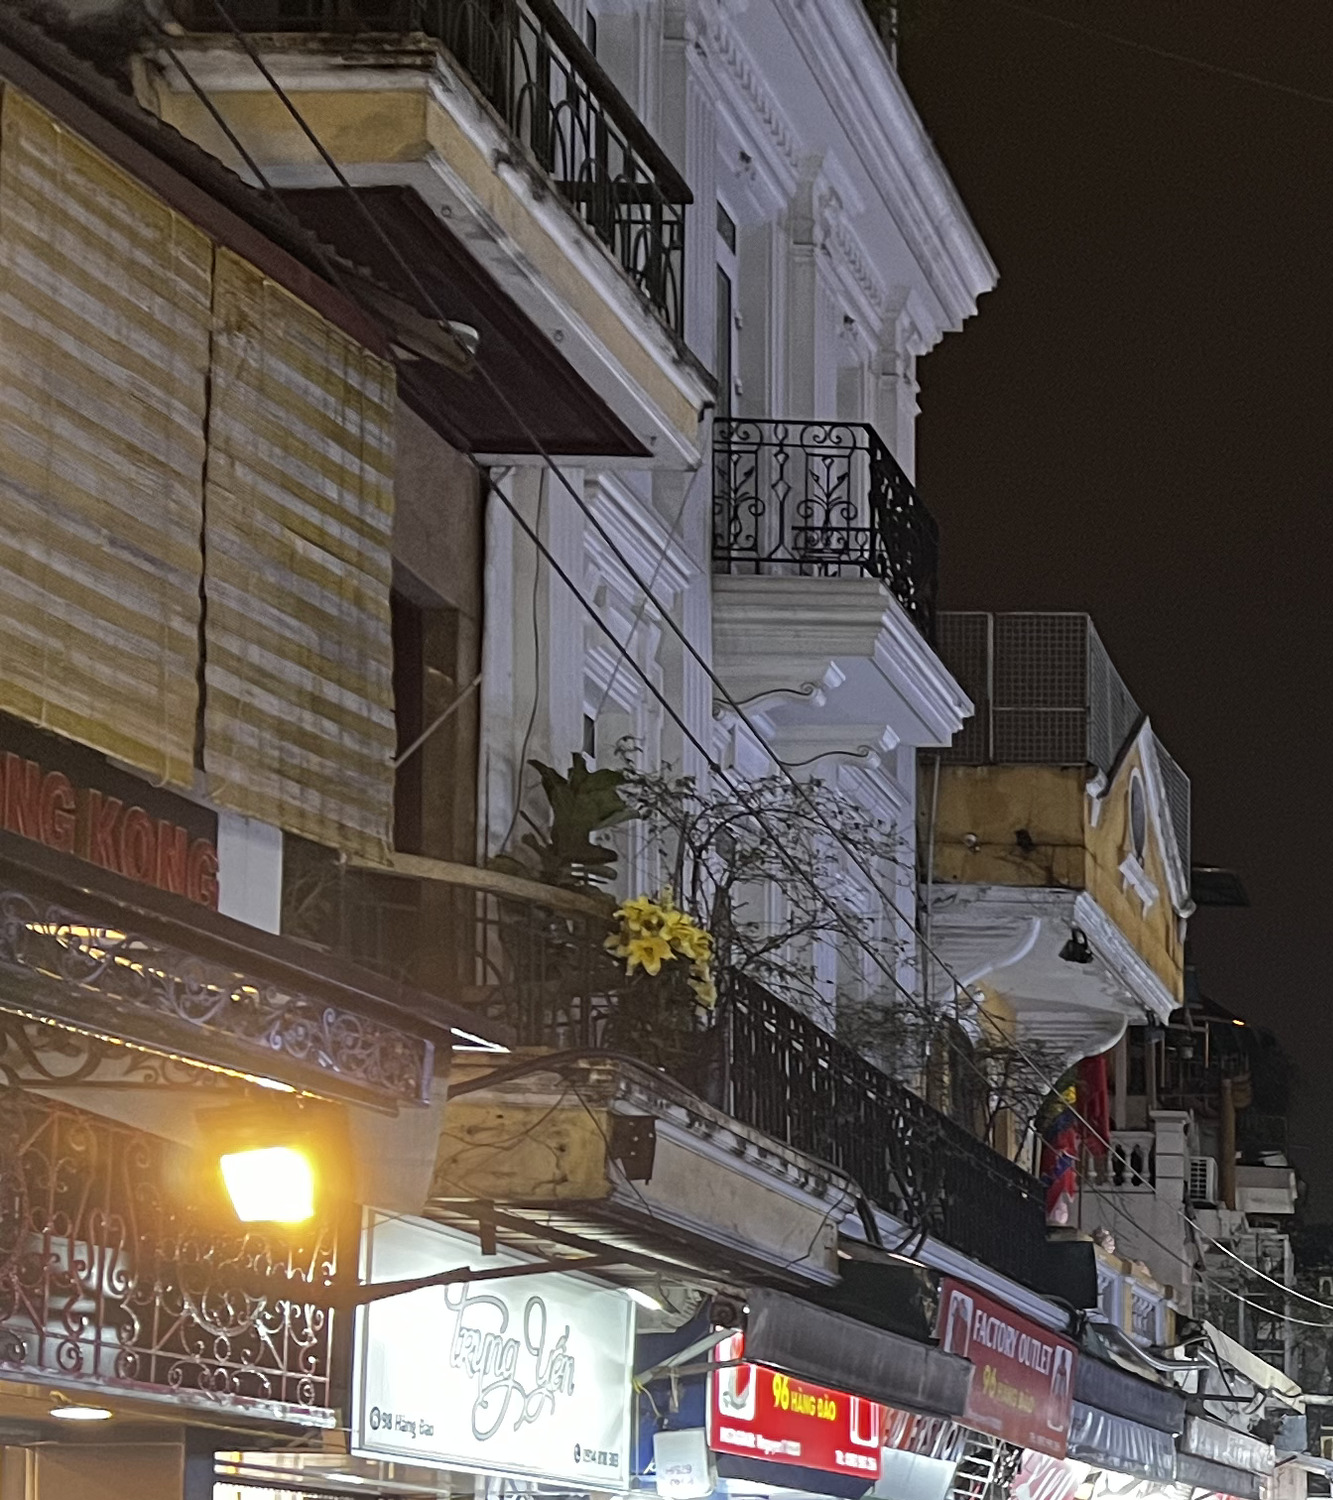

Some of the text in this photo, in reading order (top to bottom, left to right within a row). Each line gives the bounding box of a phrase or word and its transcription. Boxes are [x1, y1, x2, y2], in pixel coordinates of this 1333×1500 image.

[87, 788, 220, 913] KONG
[972, 1309, 1054, 1376] FACTORY OUTLET
[772, 1372, 791, 1410] 96
